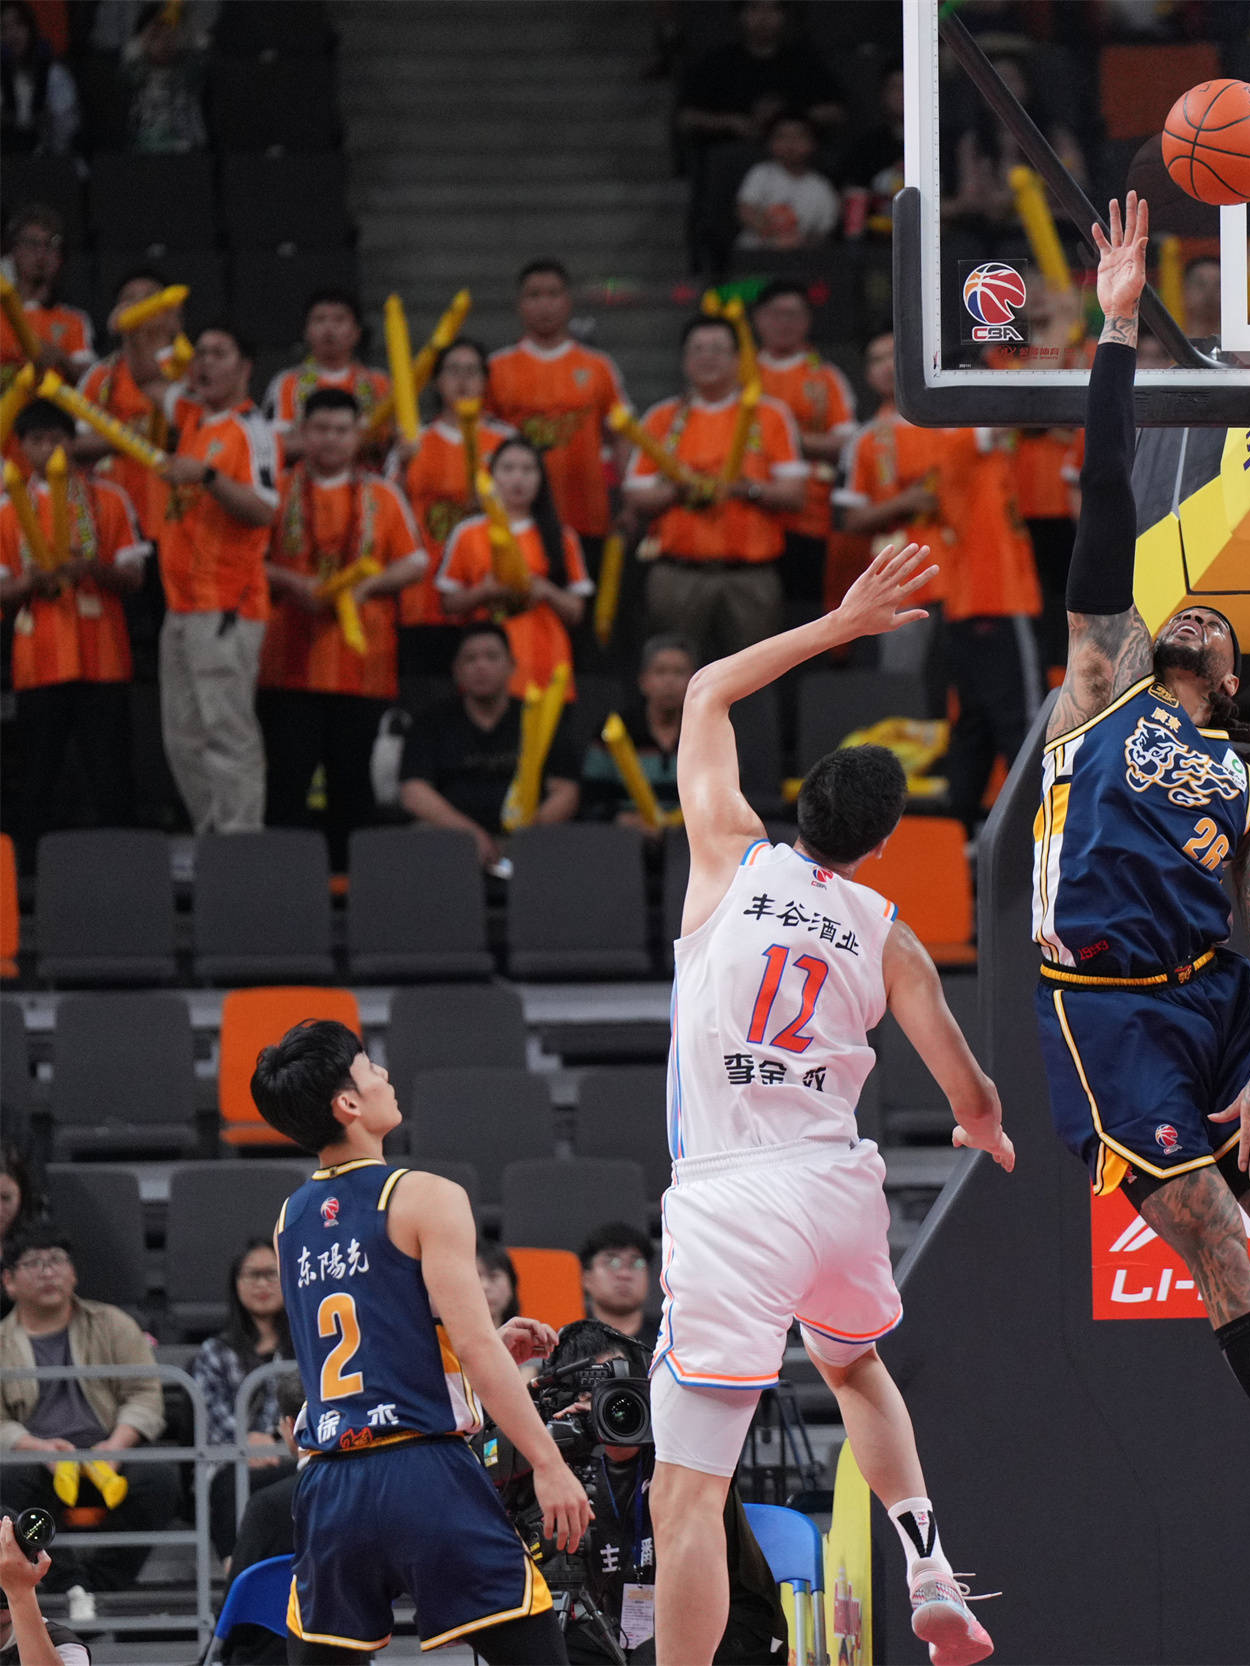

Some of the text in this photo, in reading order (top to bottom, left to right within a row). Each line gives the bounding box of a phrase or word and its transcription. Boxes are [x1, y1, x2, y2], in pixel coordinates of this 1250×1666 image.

[972, 325, 1024, 341] CBA
[1183, 816, 1230, 871] 26
[743, 893, 859, 956] 丰谷酒业
[746, 943, 829, 1054] 12
[317, 1291, 365, 1403] 2
